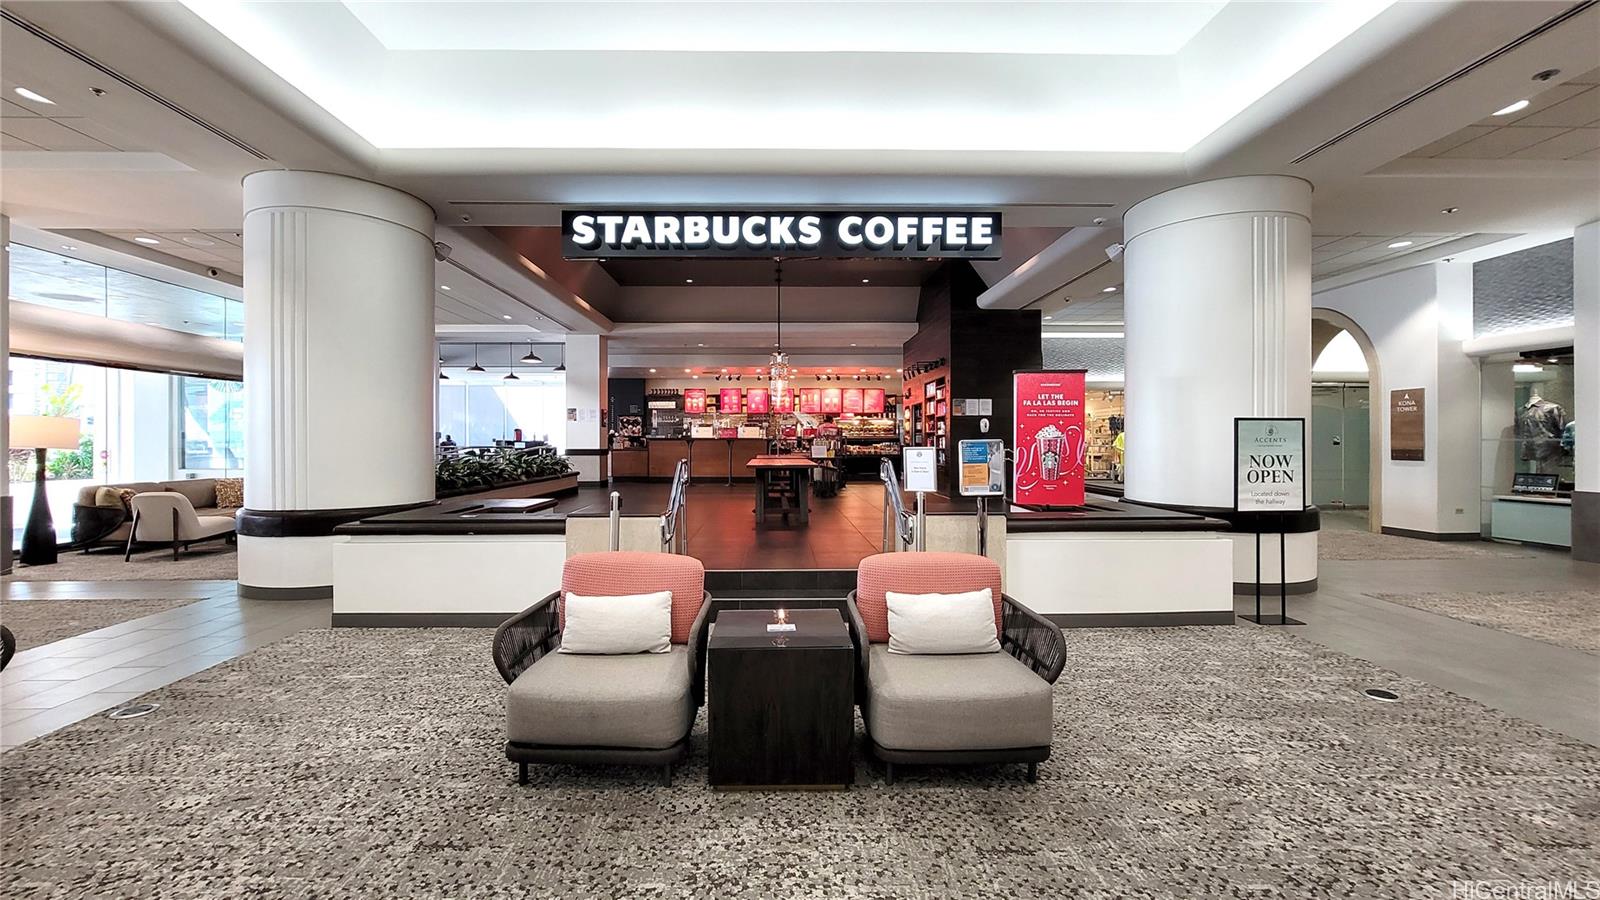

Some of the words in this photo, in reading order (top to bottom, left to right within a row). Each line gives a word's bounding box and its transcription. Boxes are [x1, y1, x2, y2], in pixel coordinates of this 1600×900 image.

[572, 215, 822, 246] STARBUCKS
[837, 215, 993, 246] COFFEE
[1249, 454, 1293, 468] NOW
[1247, 469, 1294, 484] OPEN
[1266, 498, 1286, 506] hallway
